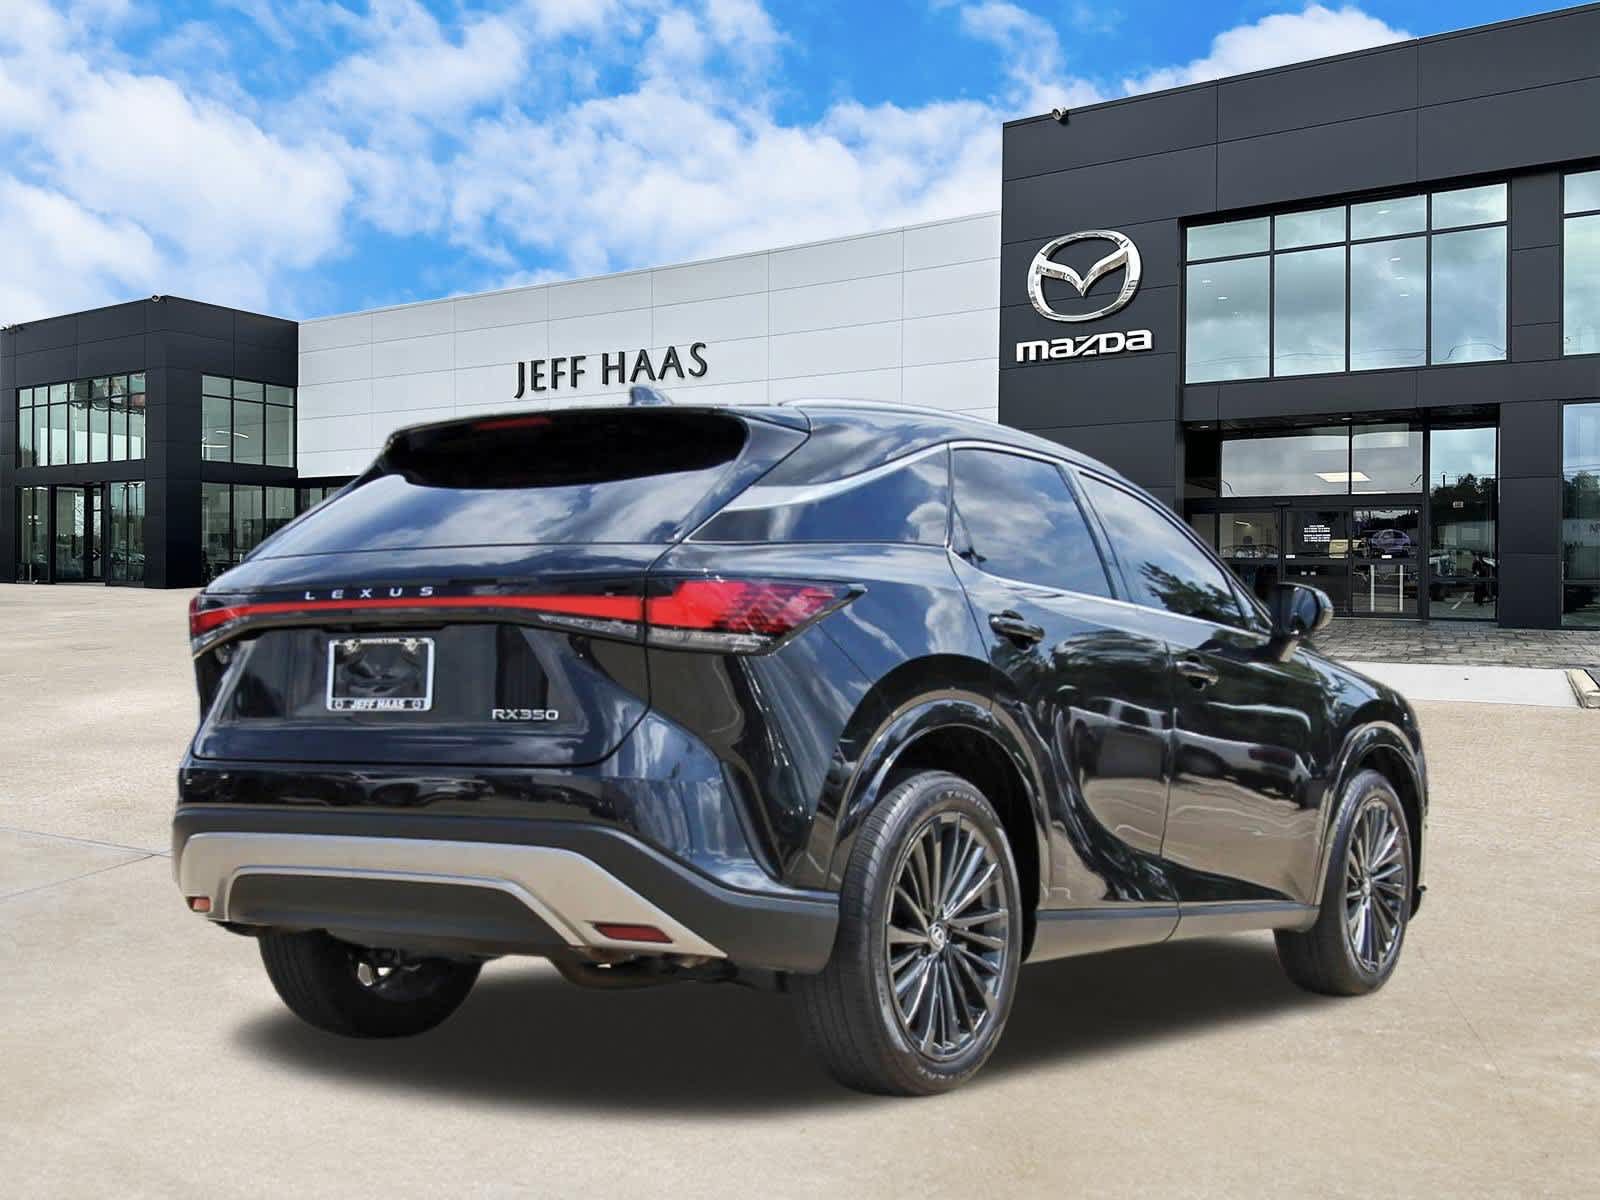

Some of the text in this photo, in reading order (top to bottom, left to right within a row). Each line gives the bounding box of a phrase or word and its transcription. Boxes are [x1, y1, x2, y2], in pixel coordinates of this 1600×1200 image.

[514, 342, 708, 399] JEFF HAAS
[304, 586, 434, 600] LEXUS
[491, 708, 560, 722] RX350
